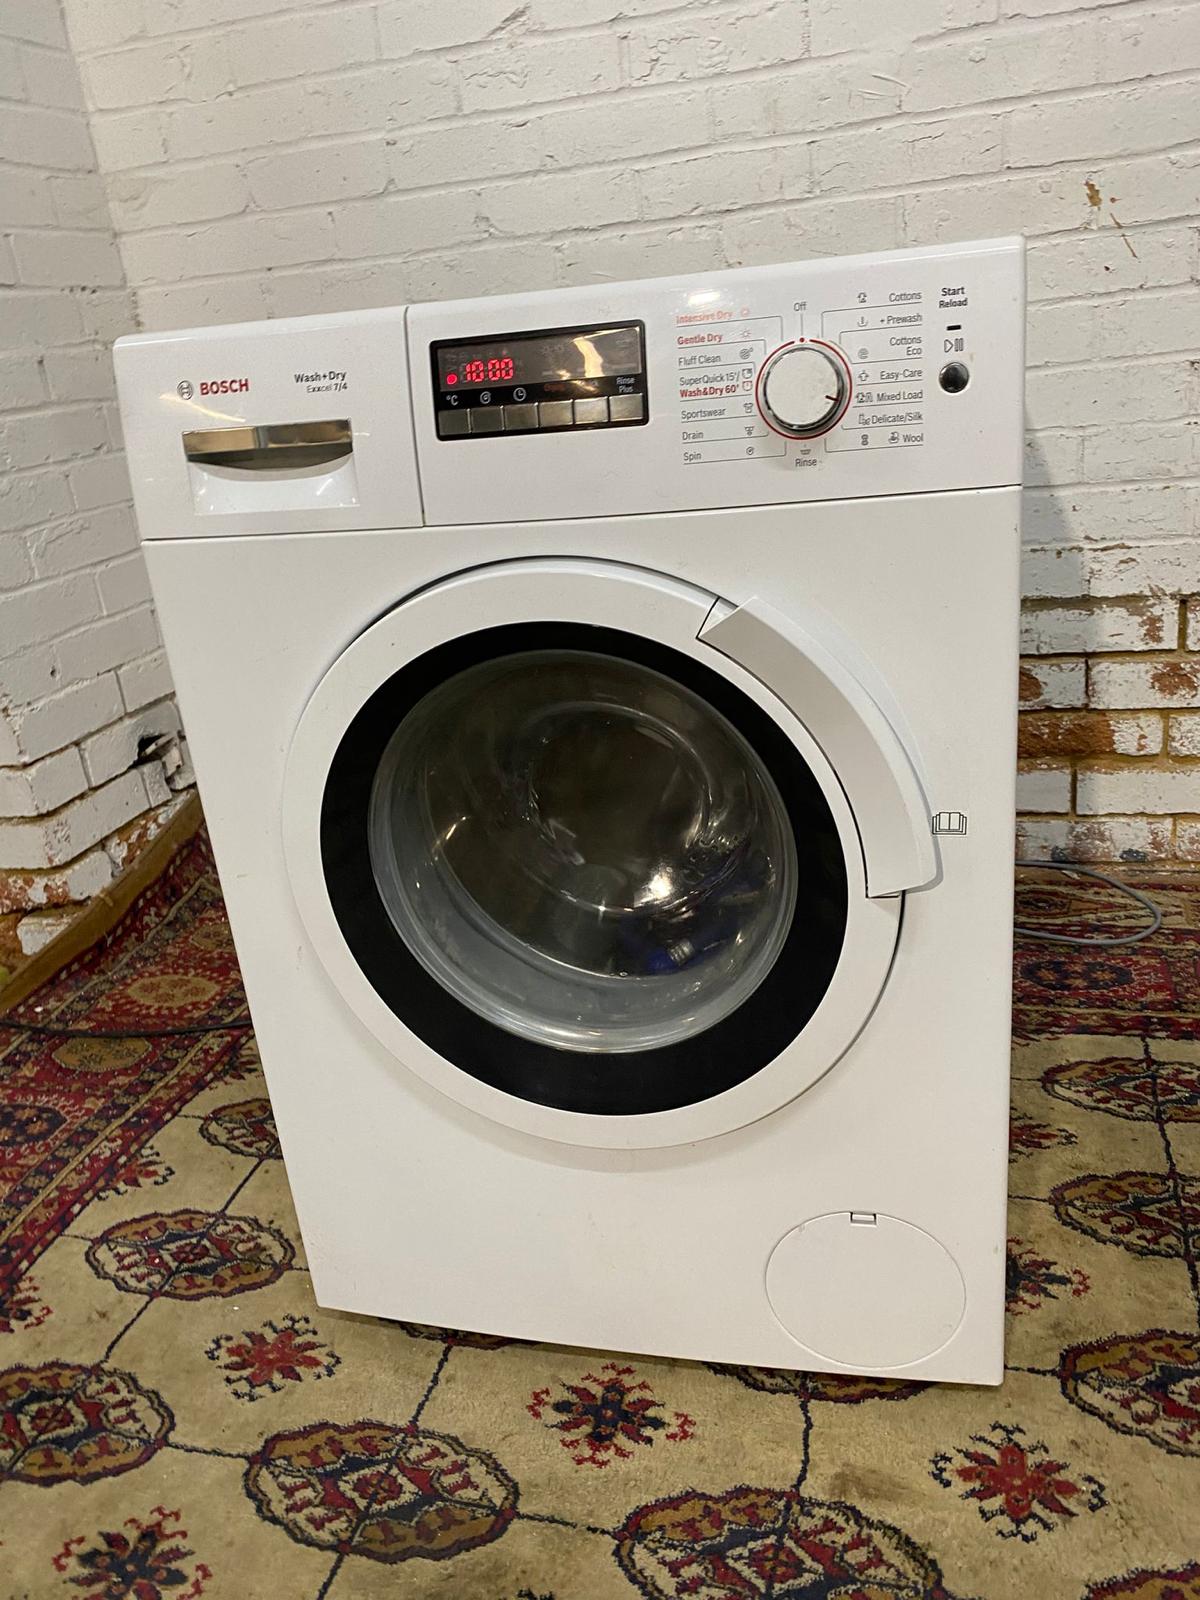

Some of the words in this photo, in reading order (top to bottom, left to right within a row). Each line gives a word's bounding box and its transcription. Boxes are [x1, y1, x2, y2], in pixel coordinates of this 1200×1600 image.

[888, 291, 922, 303] Cottons
[941, 286, 965, 297] Start
[794, 302, 807, 312] Off
[938, 298, 968, 309] Reload
[716, 310, 734, 320] Dry
[886, 313, 922, 326] Prewash
[677, 335, 705, 345] Gentle
[706, 333, 723, 343] Dry
[889, 335, 922, 347] Cottons
[906, 346, 922, 356] Eco
[678, 355, 697, 366] Fluff
[698, 354, 721, 365] Clean
[679, 373, 725, 386] SuperQuick
[879, 369, 923, 381] Easy-Care
[616, 376, 636, 386] Rinse
[200, 378, 249, 396] BOSCH
[333, 382, 348, 393] 7/4
[618, 385, 634, 394] Plus
[679, 386, 724, 398] Wash&Dry
[876, 392, 901, 402] Mixed
[902, 390, 923, 400] Load
[680, 408, 727, 420] Sportswear
[871, 413, 924, 425] Delicate/Silk
[682, 431, 704, 441] Drain
[902, 433, 924, 443] Wool
[683, 452, 702, 462] Spin
[795, 458, 818, 468] Rinse
